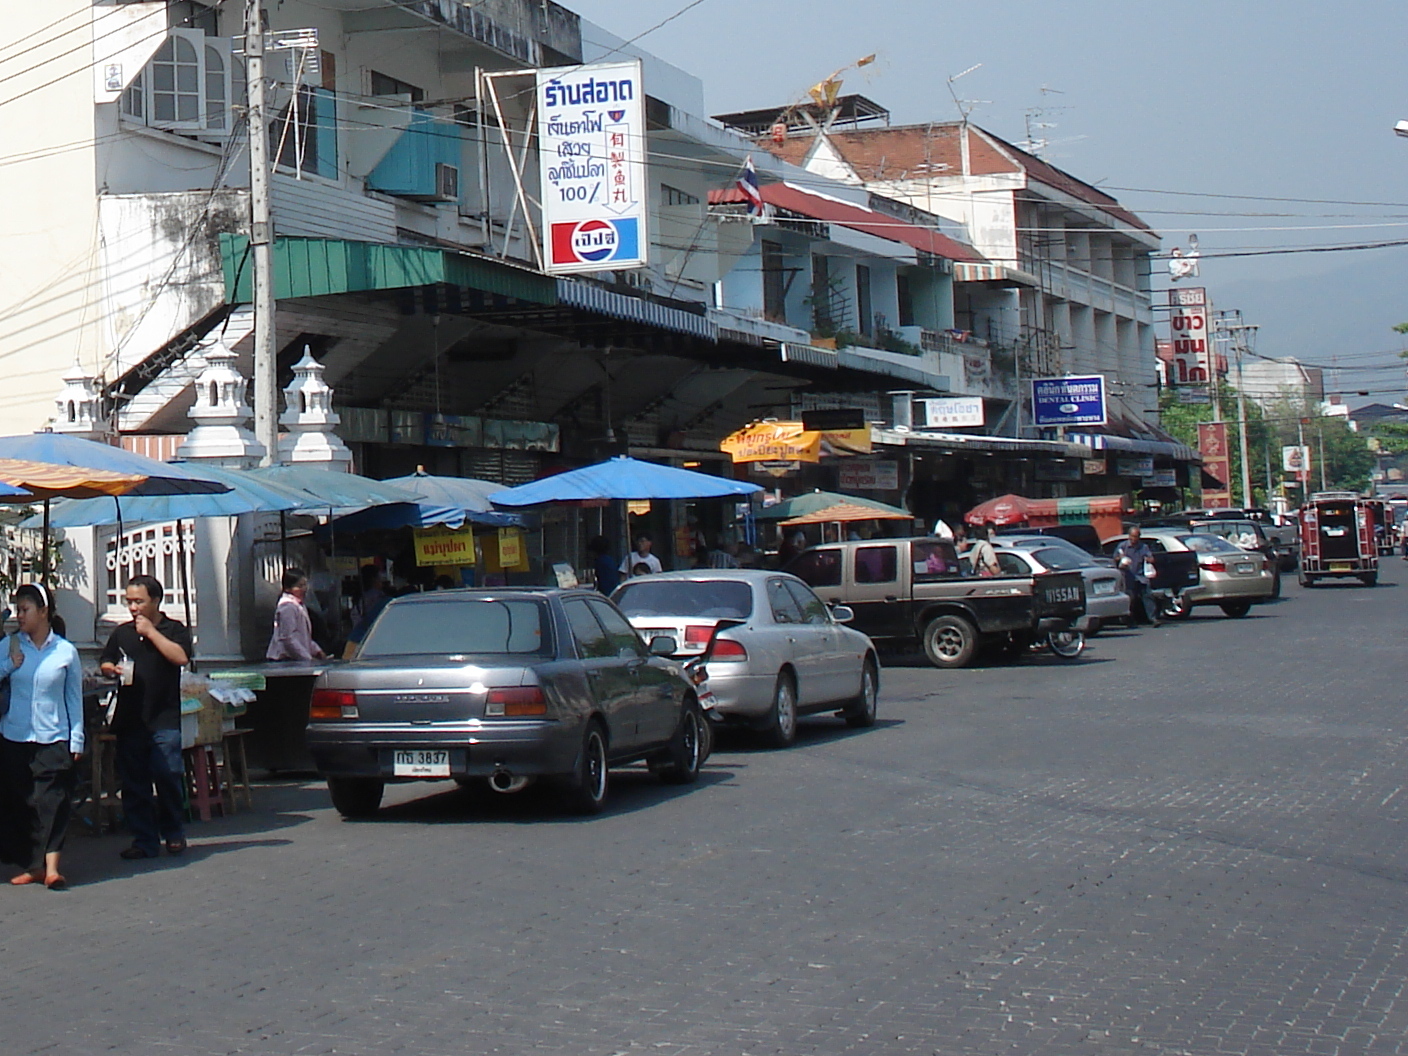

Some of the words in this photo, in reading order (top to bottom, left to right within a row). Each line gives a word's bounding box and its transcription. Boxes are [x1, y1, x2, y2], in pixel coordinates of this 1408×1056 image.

[545, 77, 633, 107] ร้านสอาด
[547, 157, 605, 186] ลูกชิ้นปลา
[1174, 333, 1205, 354] มัน
[1175, 357, 1207, 382] ไก่
[1070, 395, 1099, 403] CLINIC
[1045, 586, 1080, 604] NISSAN
